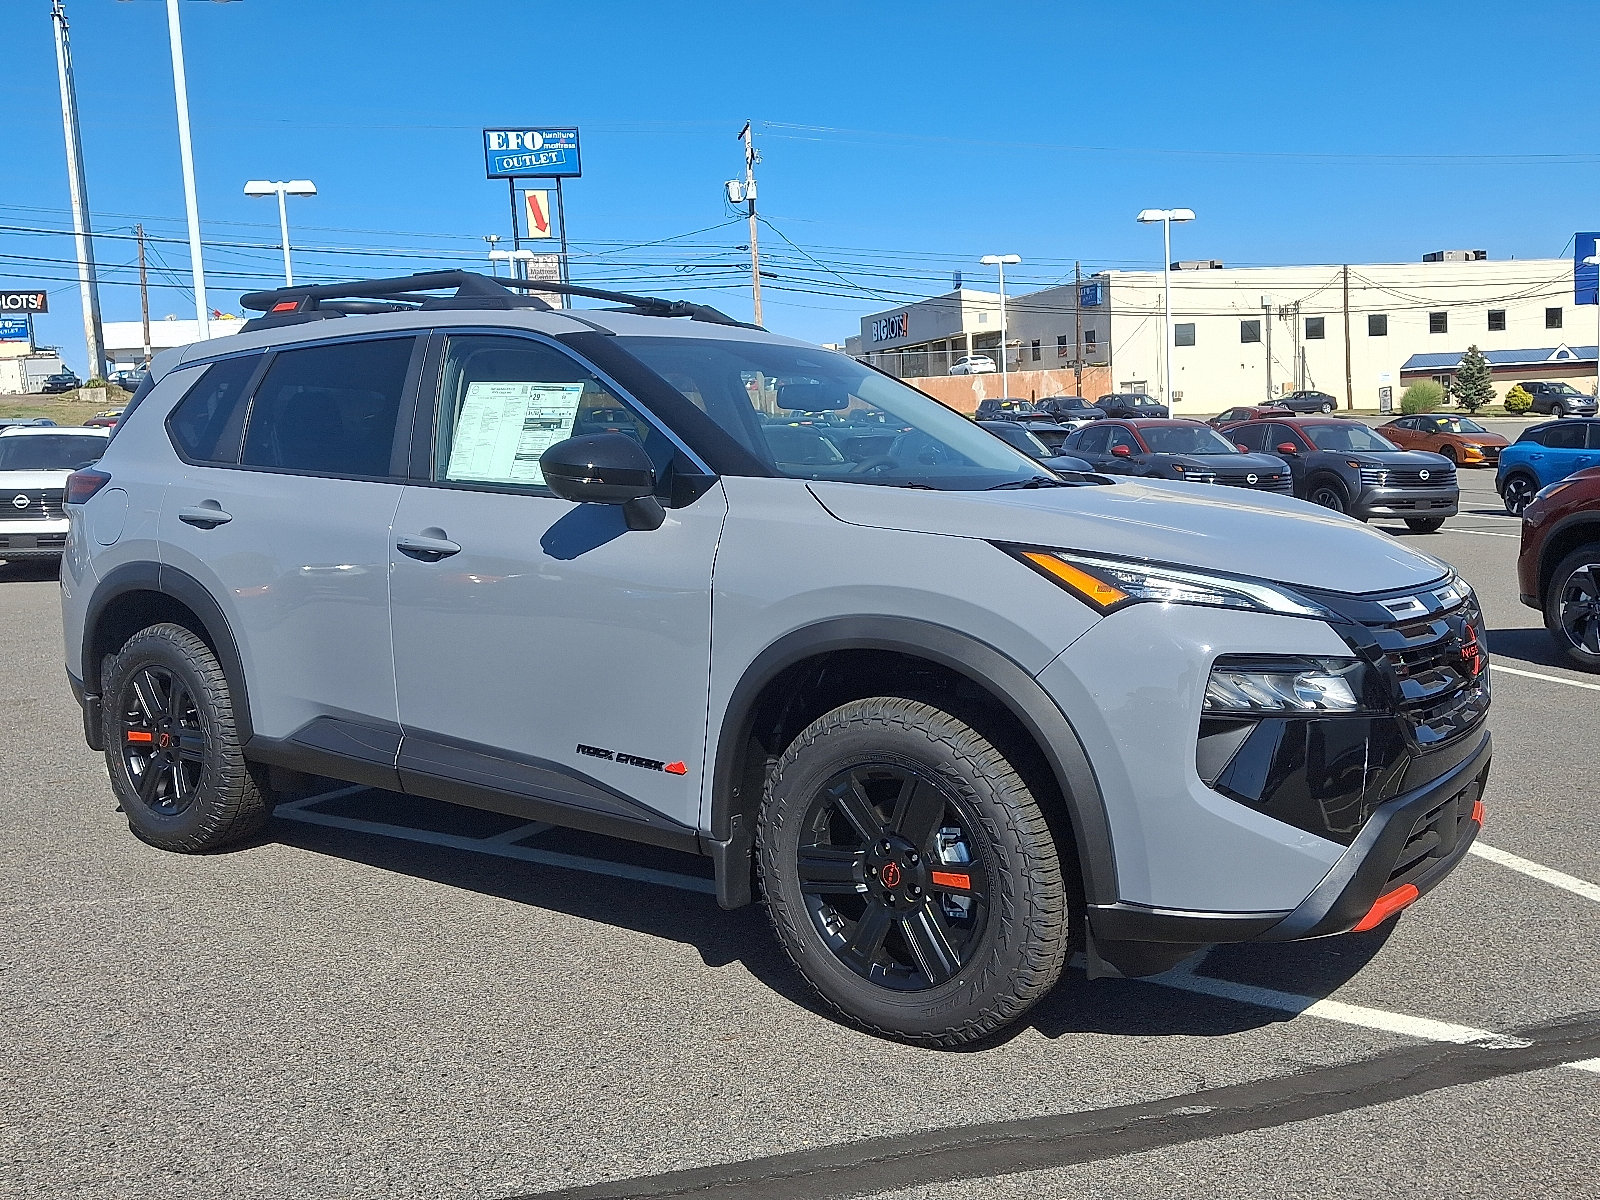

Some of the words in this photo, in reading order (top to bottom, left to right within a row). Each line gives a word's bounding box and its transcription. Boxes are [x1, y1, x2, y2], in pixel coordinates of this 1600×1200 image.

[487, 131, 543, 150] EFO
[503, 152, 558, 168] OUTLET
[0, 294, 43, 309] LOTS!
[532, 393, 541, 401] 29
[576, 743, 615, 761] ROCK
[616, 752, 665, 771] CREEK
